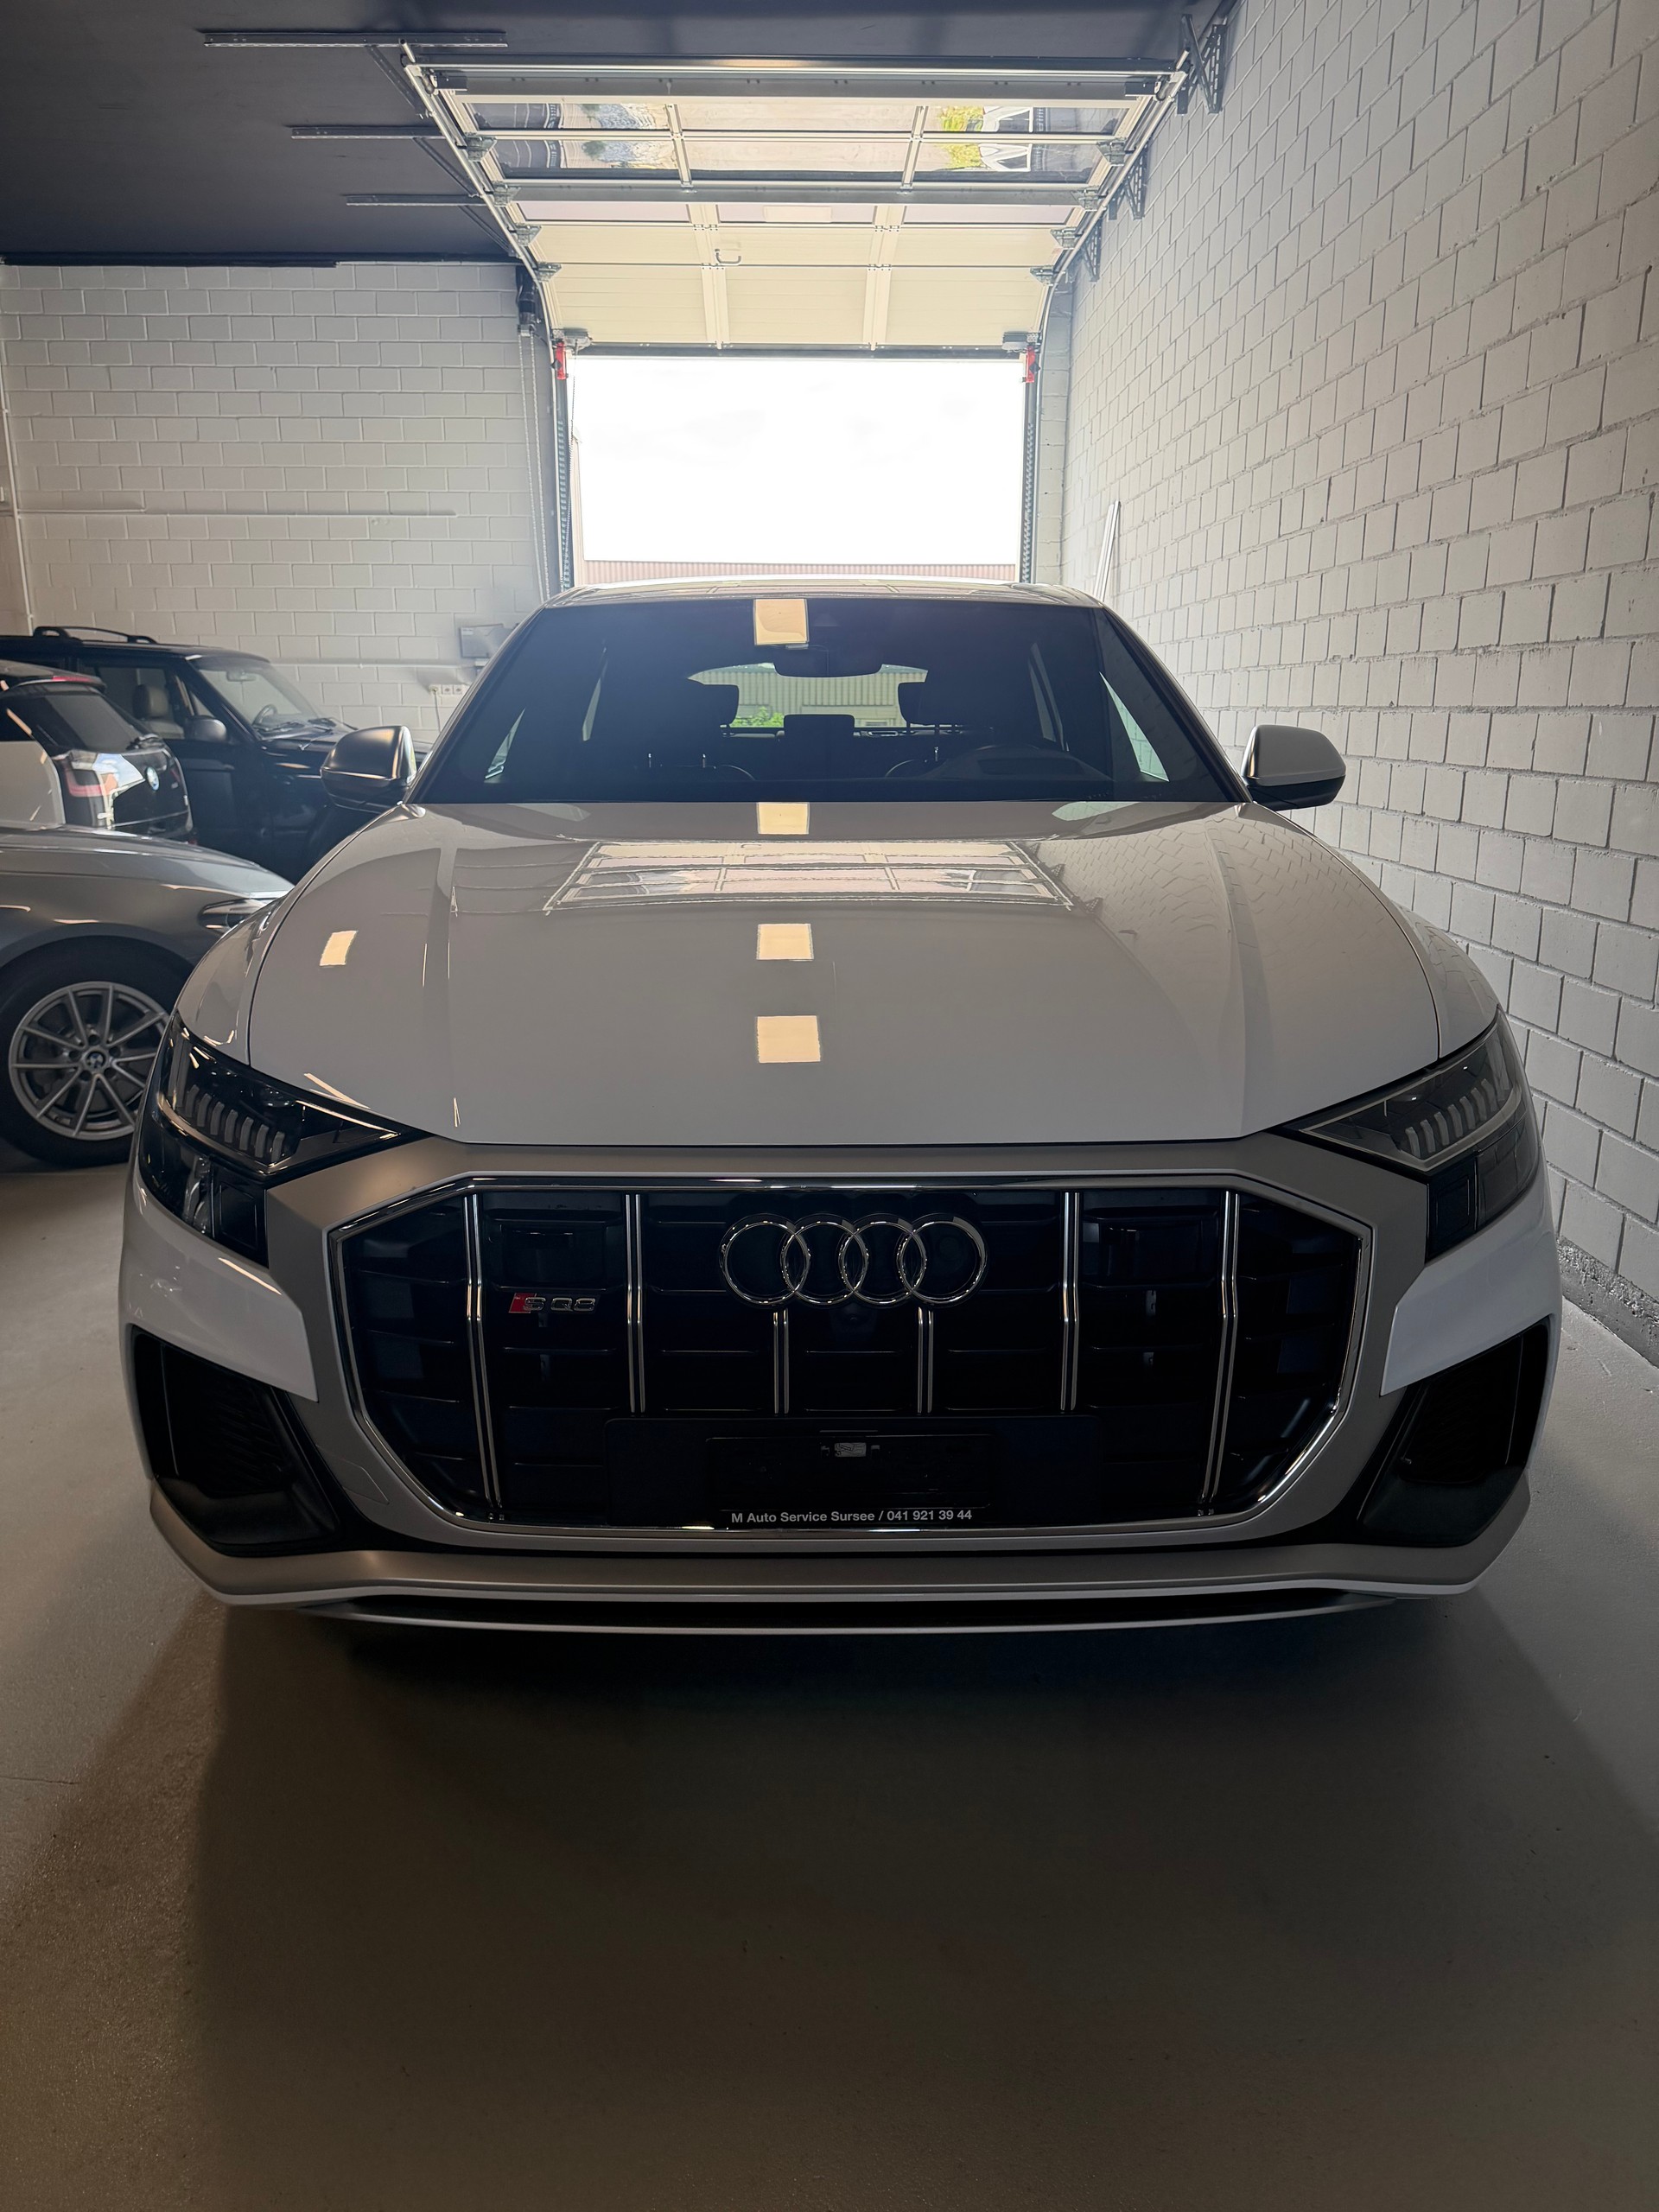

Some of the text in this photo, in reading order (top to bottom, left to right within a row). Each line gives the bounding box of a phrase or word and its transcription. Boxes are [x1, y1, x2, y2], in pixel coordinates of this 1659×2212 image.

[731, 1510, 973, 1522] M Auto Service Sursee / 041 921 39 44
